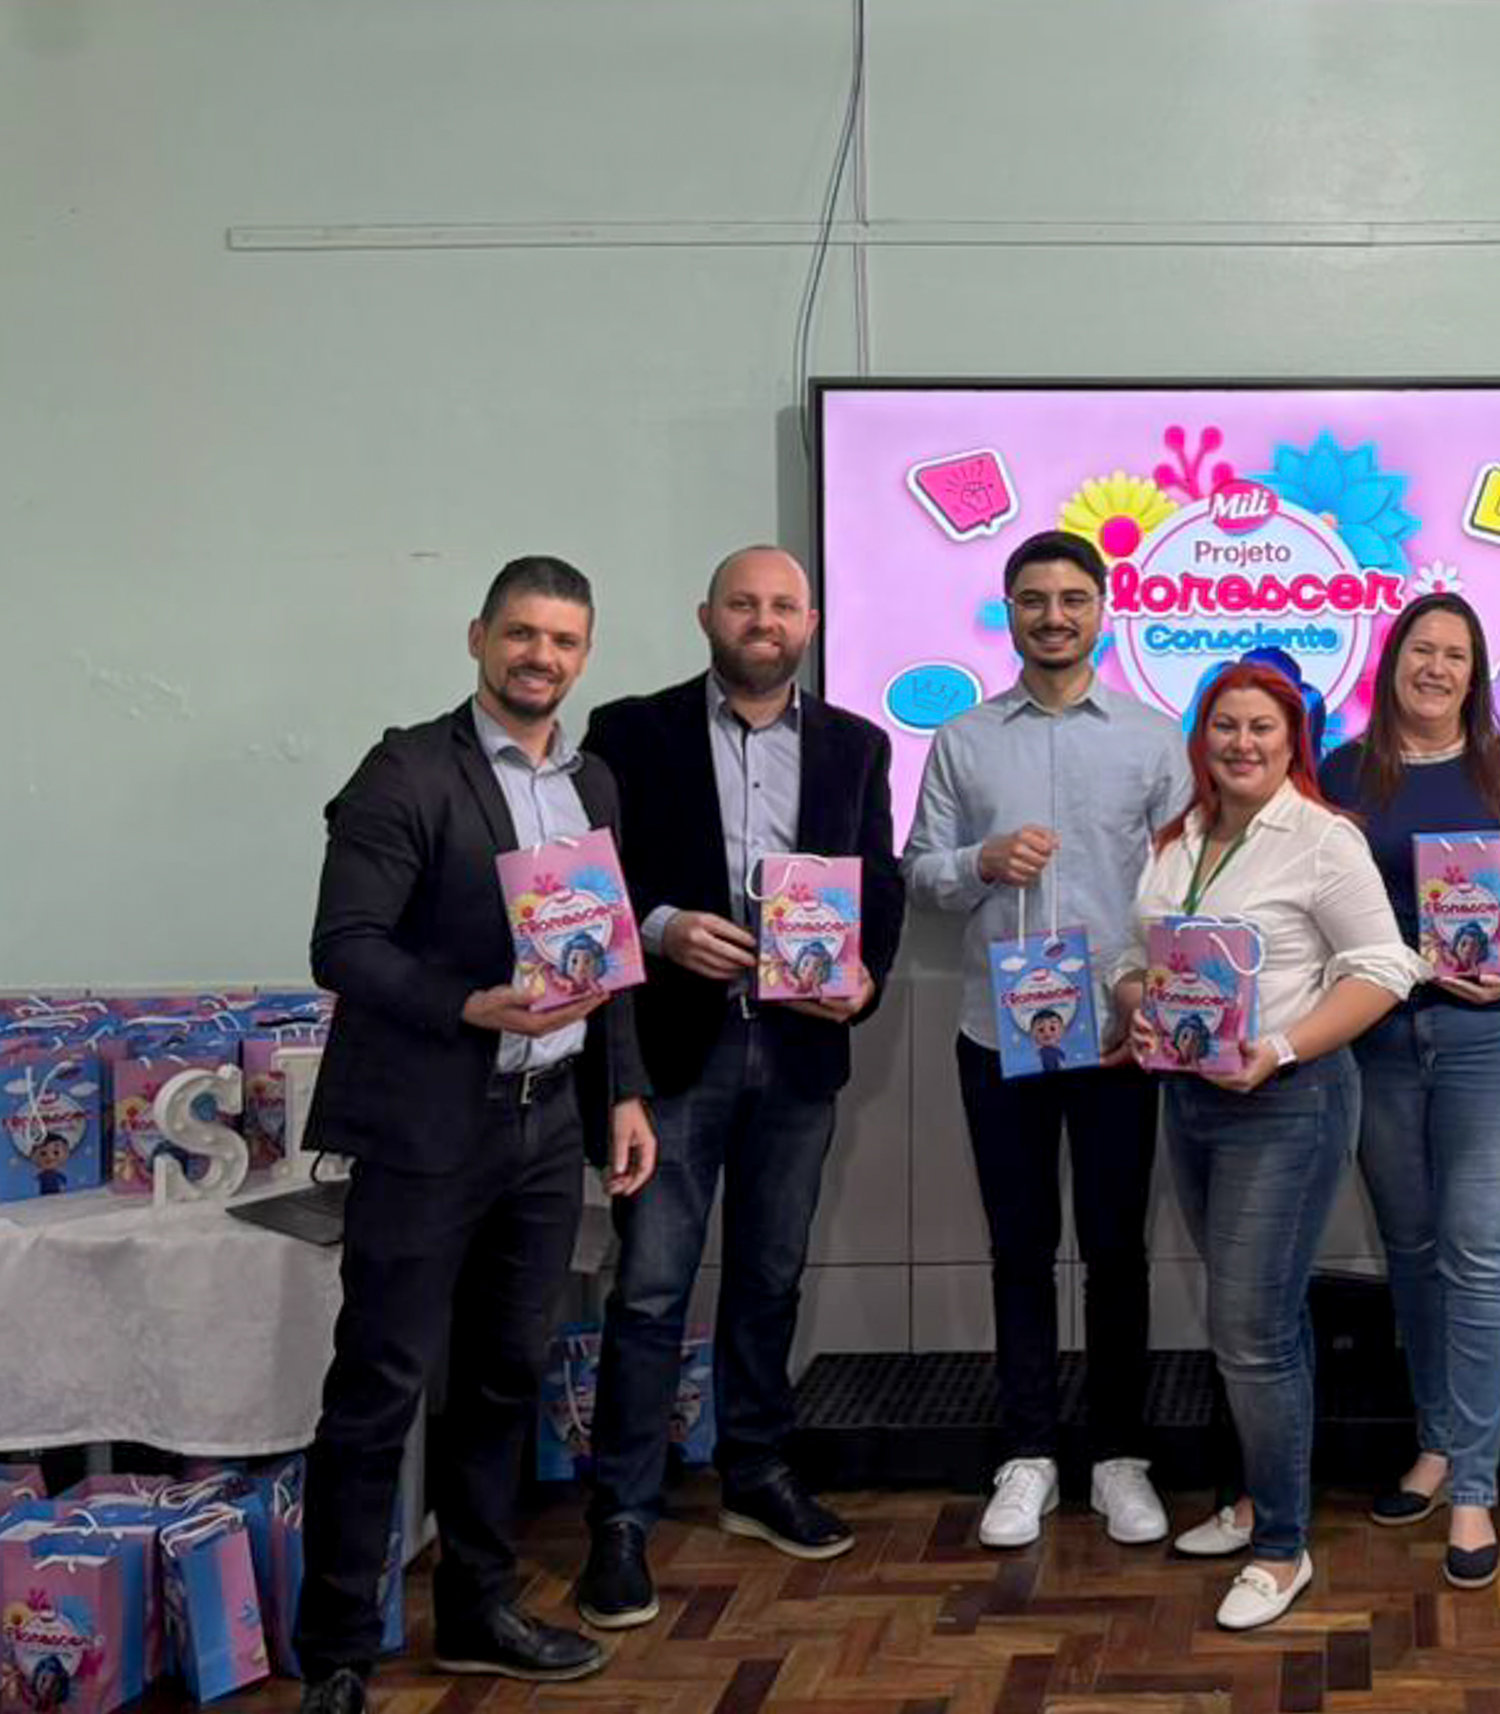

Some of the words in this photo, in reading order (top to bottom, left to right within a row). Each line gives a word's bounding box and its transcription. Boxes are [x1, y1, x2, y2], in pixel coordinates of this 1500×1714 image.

[1210, 491, 1269, 519] Mili
[1195, 540, 1291, 567] Projeto
[1110, 561, 1401, 613] lorescer
[1145, 623, 1338, 650] Consciente
